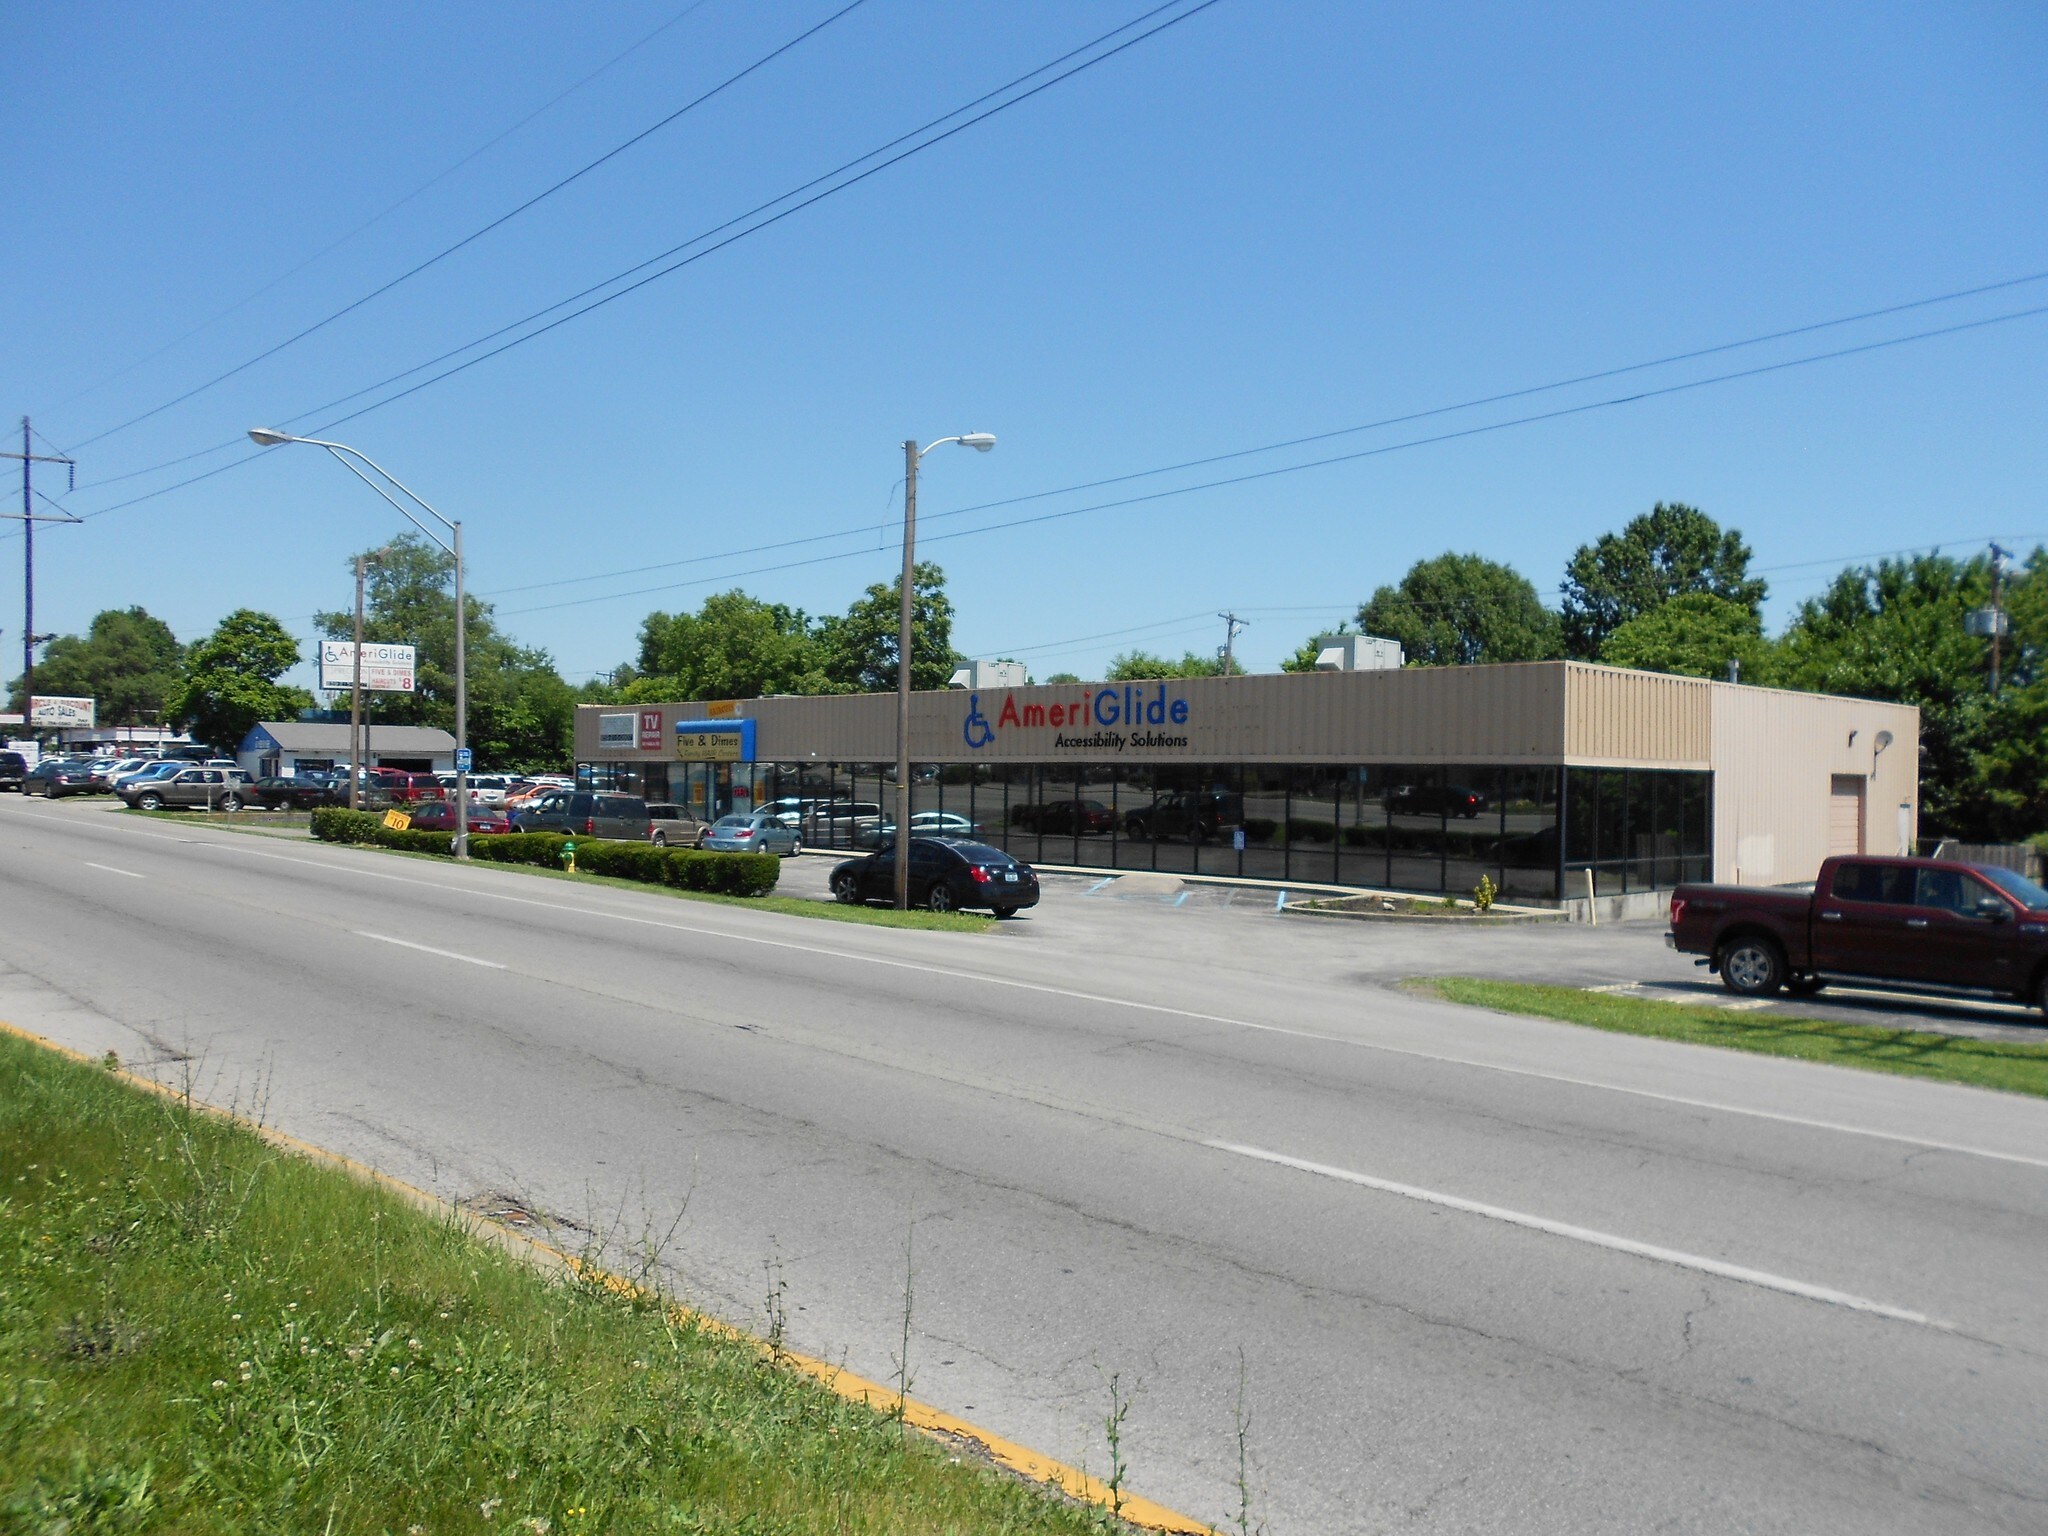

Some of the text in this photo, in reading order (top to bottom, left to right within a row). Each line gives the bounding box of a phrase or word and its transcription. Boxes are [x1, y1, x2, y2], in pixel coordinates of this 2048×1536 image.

[393, 669, 412, 677] DIMES
[38, 705, 76, 717] AUTO SALES
[998, 684, 1189, 728] AmeriGlide
[644, 714, 658, 729] TV
[677, 734, 738, 747] Five & Dimes
[1055, 730, 1188, 751] Accessibility Solutions
